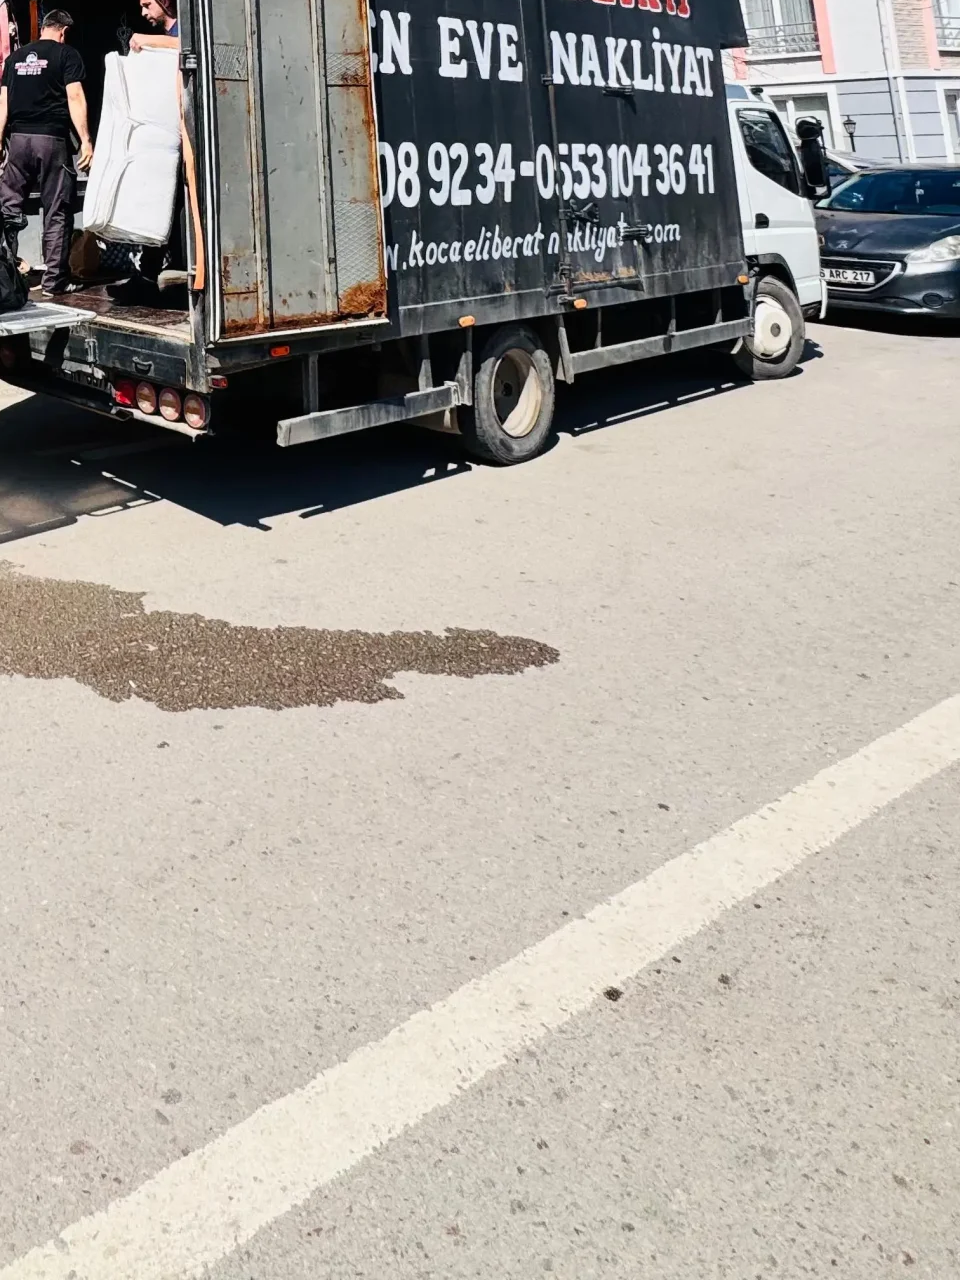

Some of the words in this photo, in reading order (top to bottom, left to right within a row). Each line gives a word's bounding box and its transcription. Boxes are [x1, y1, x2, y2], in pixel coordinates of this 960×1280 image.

[437, 16, 524, 83] EVE
[550, 26, 714, 98] NAKLİYAT
[829, 269, 849, 280] ARC
[852, 271, 871, 282] 217
